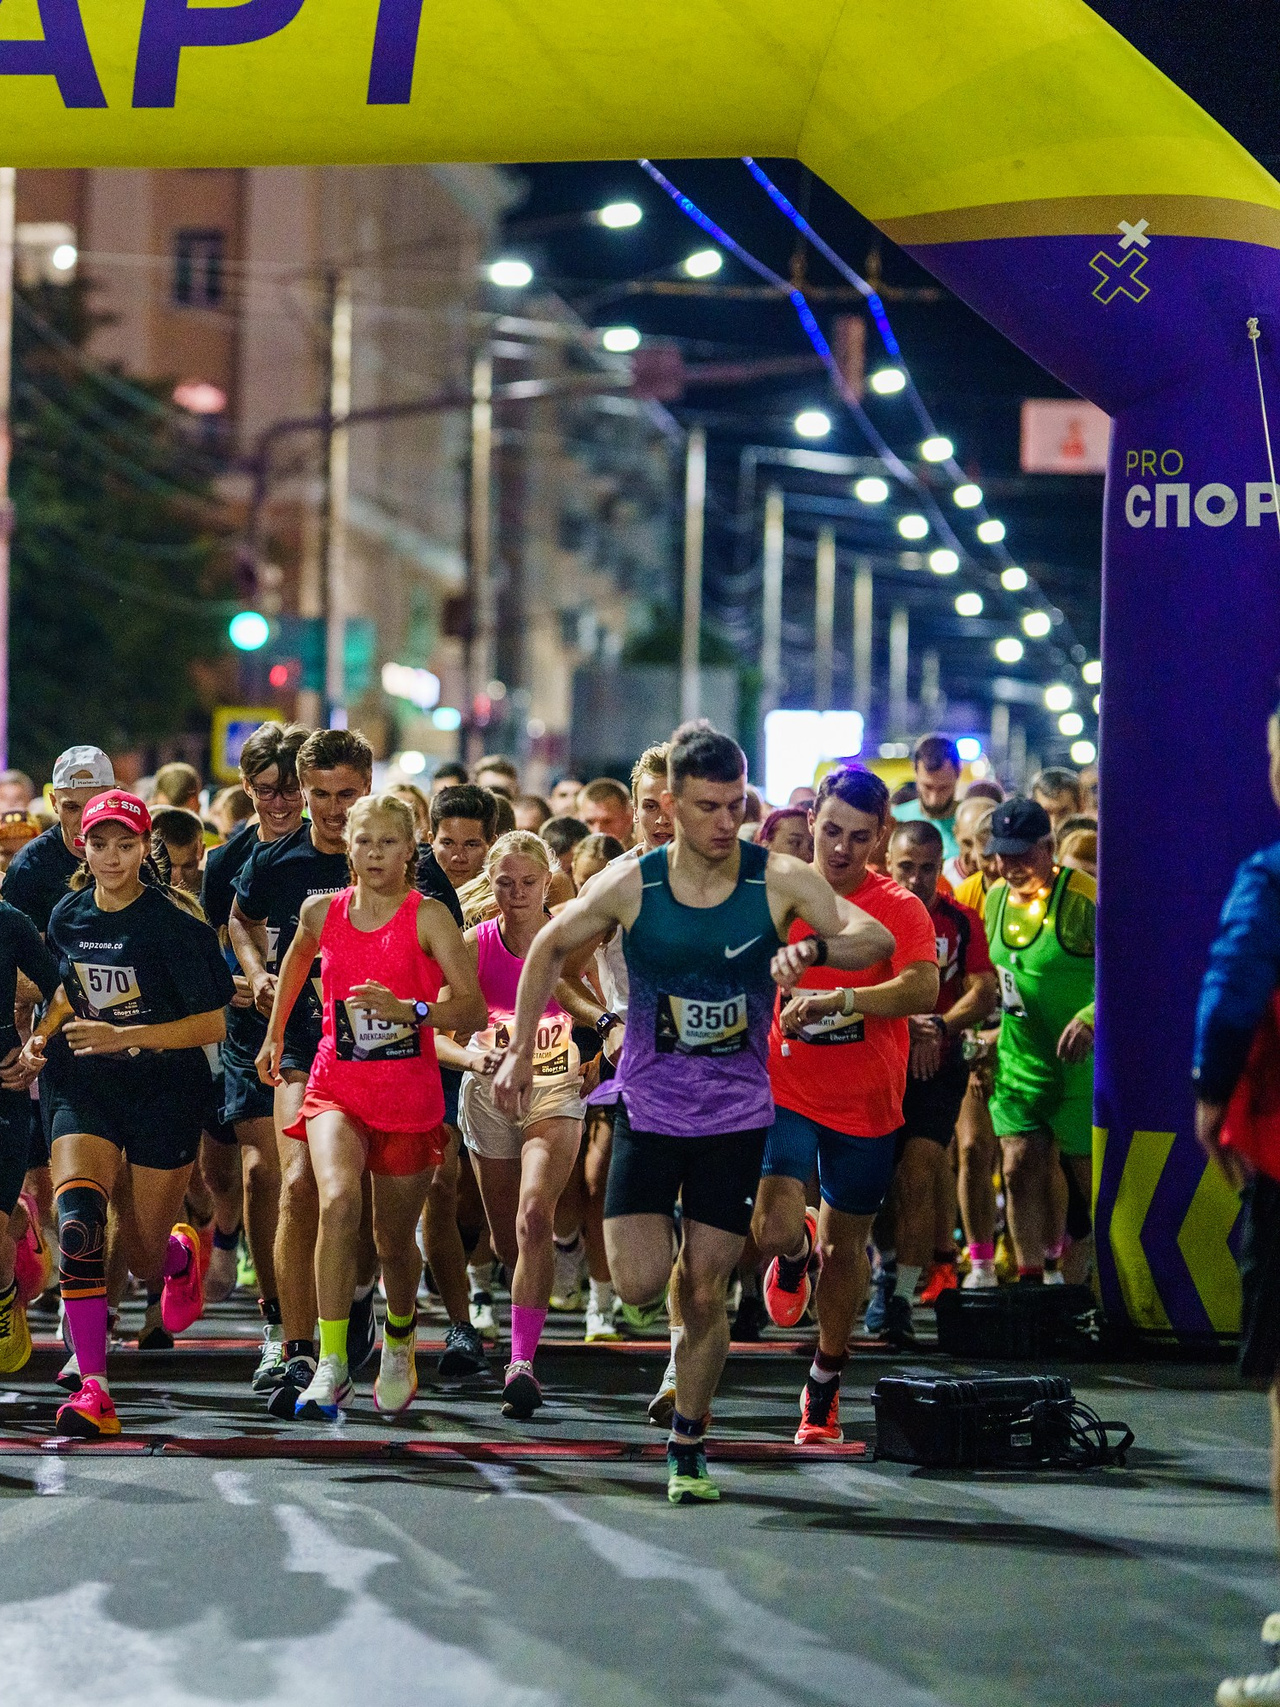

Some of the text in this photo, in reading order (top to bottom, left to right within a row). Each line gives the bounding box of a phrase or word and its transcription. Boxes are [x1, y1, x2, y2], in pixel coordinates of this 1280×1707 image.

[1126, 449, 1184, 477] PRO
[78, 941, 123, 950] appzone.co
[88, 967, 131, 994] 570
[687, 1002, 738, 1030] 350
[359, 1032, 399, 1041] АЛЕКСАНДРА
[534, 1024, 563, 1051] 02
[532, 1051, 552, 1059] СТАСИЯ
